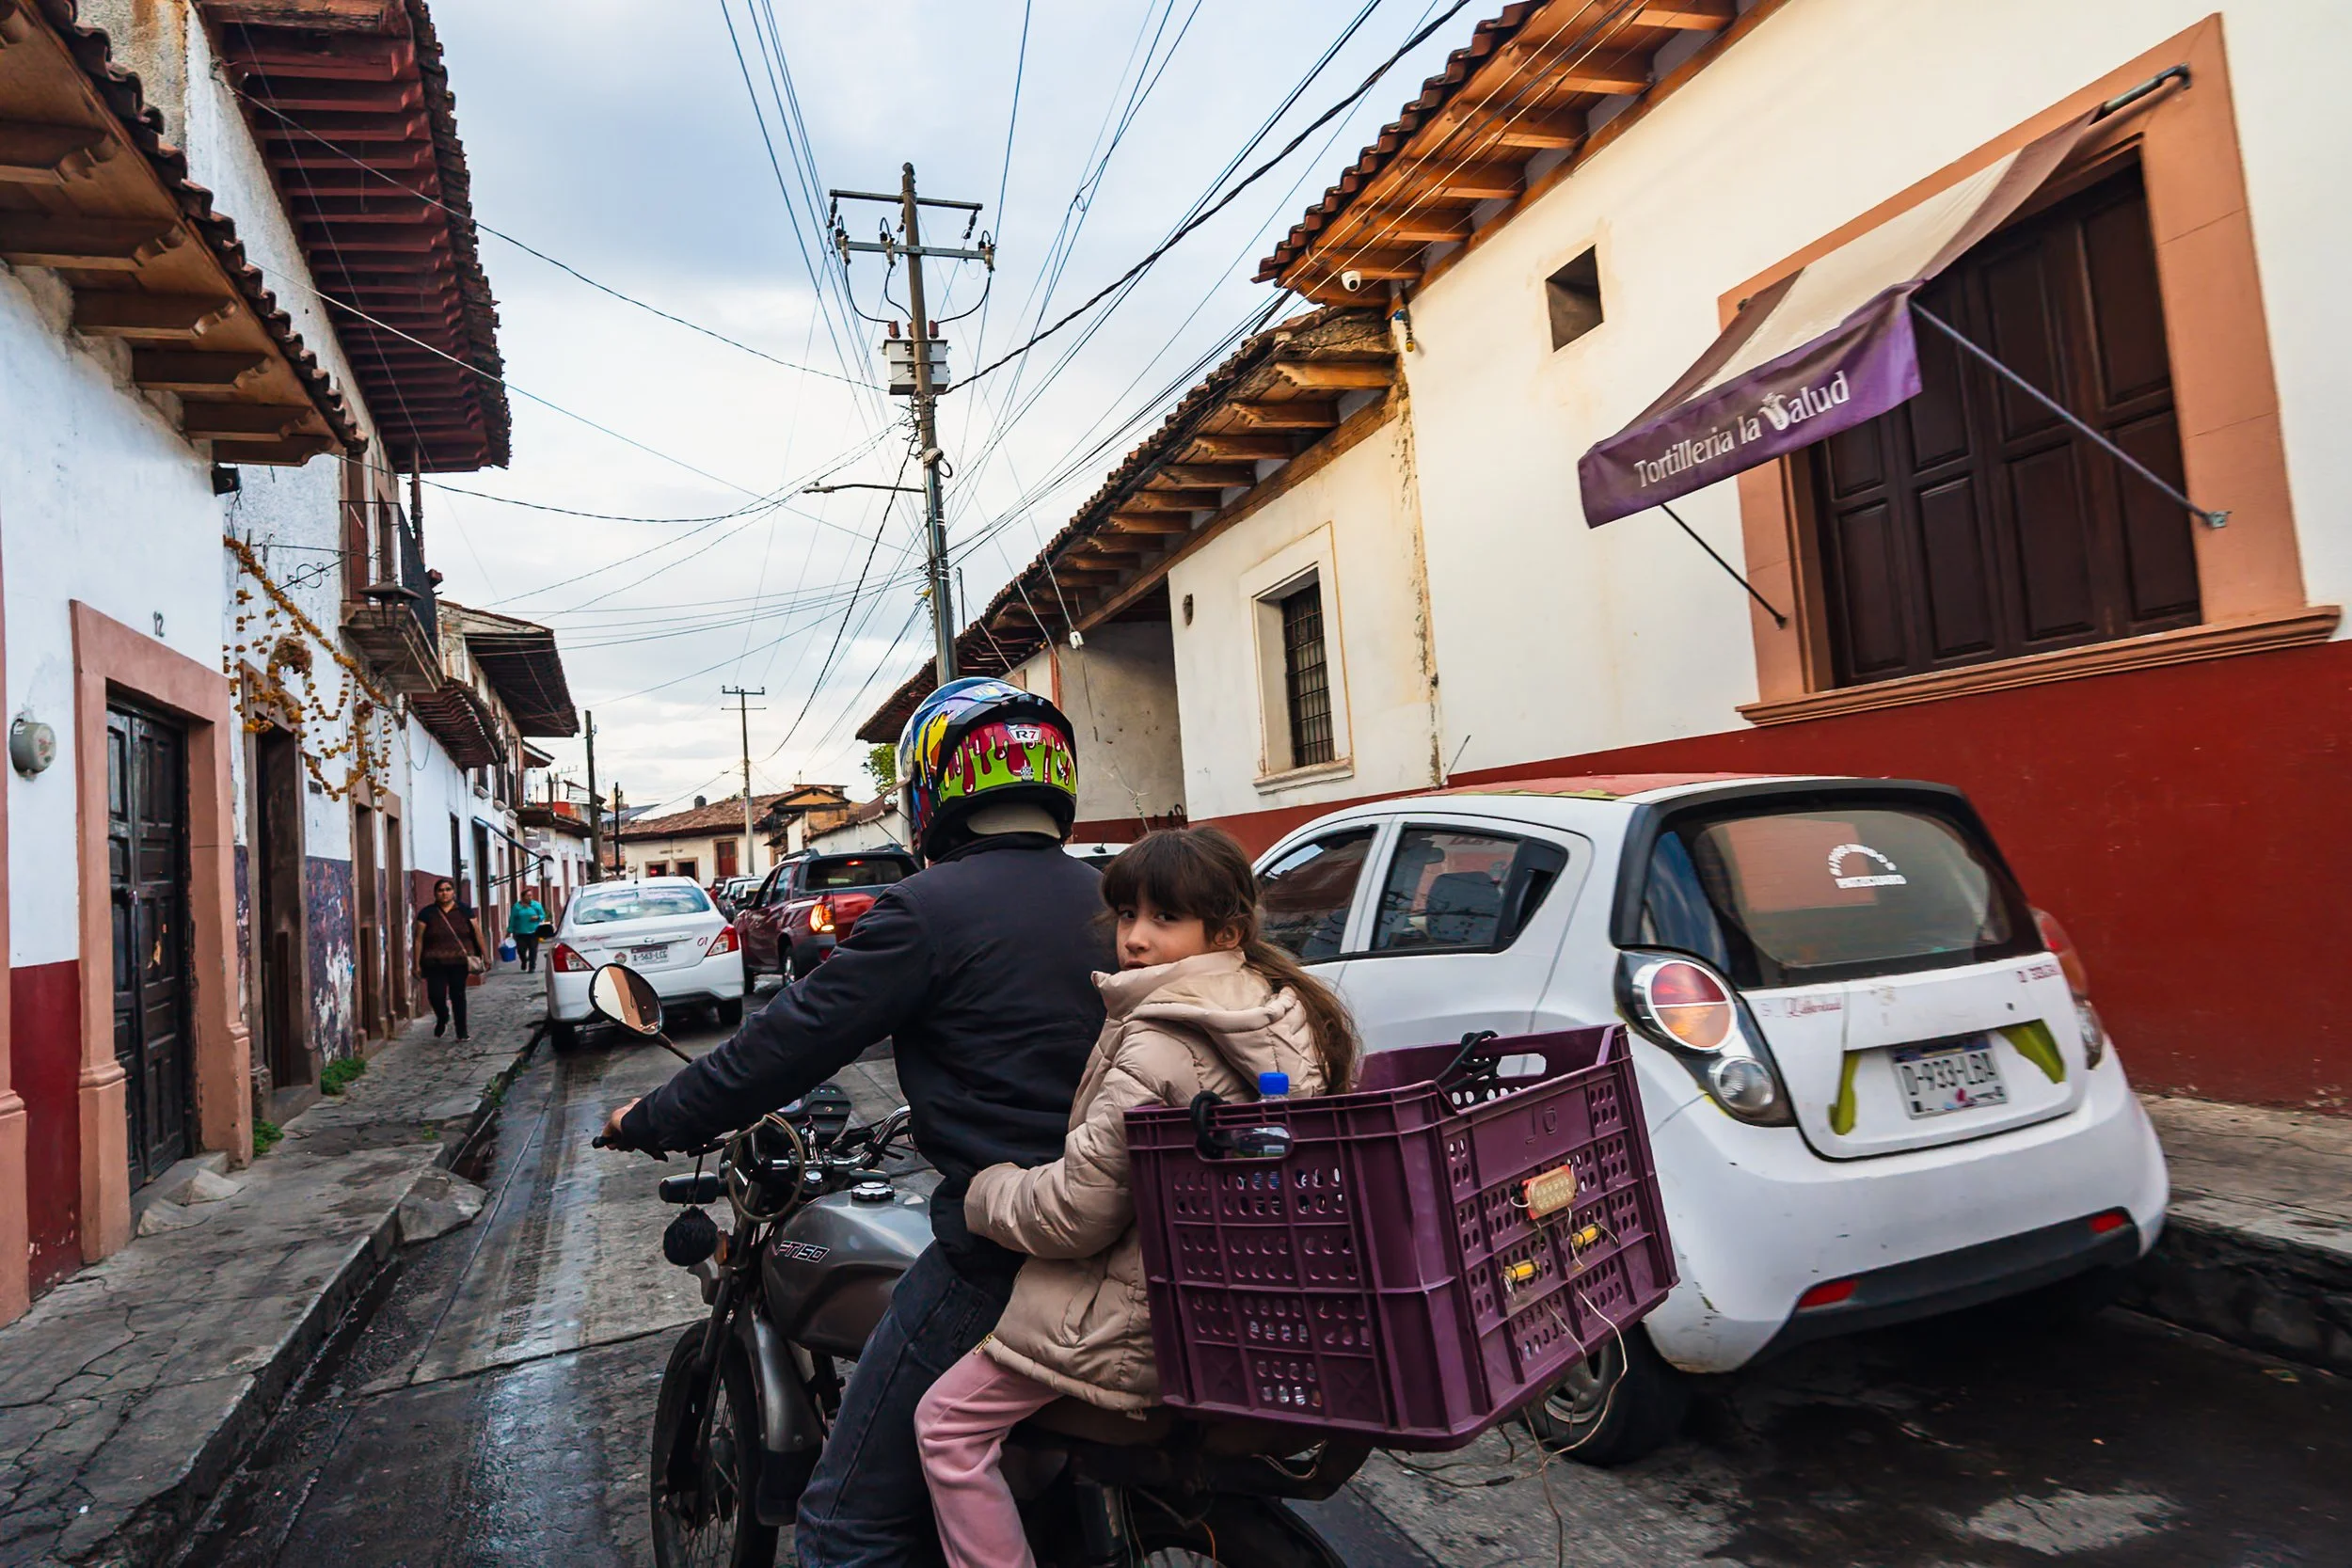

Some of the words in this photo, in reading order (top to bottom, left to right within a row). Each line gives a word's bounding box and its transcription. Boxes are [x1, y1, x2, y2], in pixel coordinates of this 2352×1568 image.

[1737, 415, 1763, 445] la
[1758, 370, 1851, 431] Salud
[153, 611, 165, 638] 12
[1016, 730, 1037, 739] R7
[775, 1240, 830, 1263] FT150
